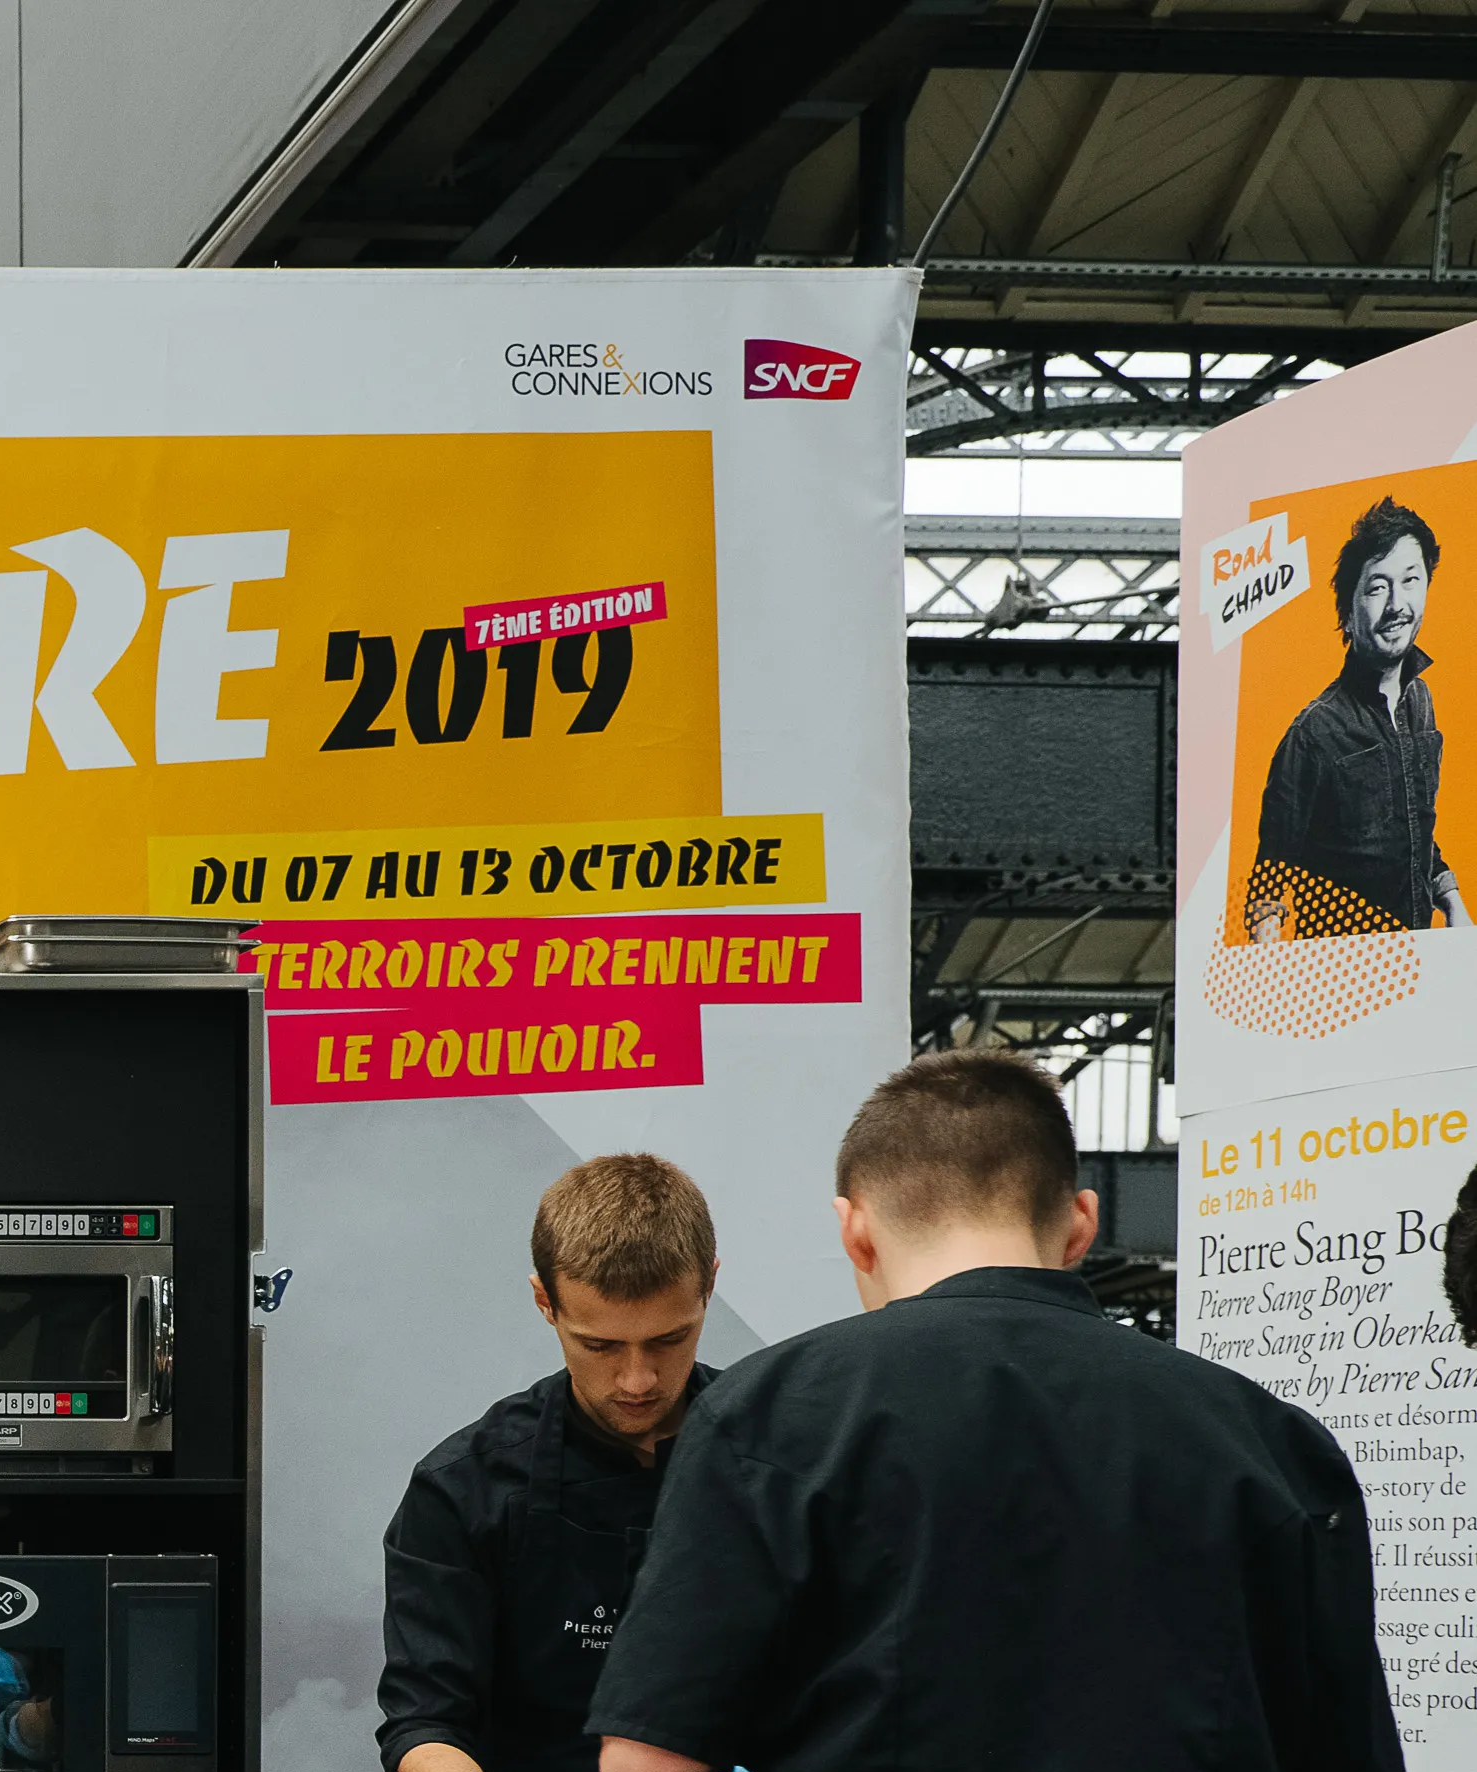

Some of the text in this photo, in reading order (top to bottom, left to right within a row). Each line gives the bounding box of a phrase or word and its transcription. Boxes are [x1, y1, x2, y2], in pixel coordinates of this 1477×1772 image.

[504, 343, 624, 370] GARES &
[511, 371, 713, 396] CONNEXIONS
[749, 362, 853, 393] SNCF
[1222, 564, 1295, 624] CHAUD
[474, 587, 654, 645] 7ÈME ÉDITION
[319, 625, 634, 752] 2019
[190, 837, 783, 905] DU 07 AU 13 OCTOBRE
[250, 936, 829, 990] TERROIRS PRENNENT
[315, 1020, 656, 1084] LE POUVOIR.
[1201, 1107, 1469, 1179] Le 11 octobre
[1199, 1178, 1317, 1217] de 12h à 14h
[12, 1219, 20, 1231] 6
[29, 1219, 37, 1231] 7
[45, 1219, 53, 1231] 8
[61, 1219, 69, 1231] 9
[78, 1219, 86, 1231] 0
[1198, 1233, 1286, 1278] Pierre
[1293, 1220, 1387, 1275] Sang
[1196, 1275, 1394, 1321] Pierre Sang Boyer
[1198, 1332, 1255, 1361] Pierre
[1257, 1325, 1316, 1364] Sang
[1319, 1321, 1345, 1352] in
[1306, 1363, 1335, 1407] by
[1338, 1362, 1420, 1395] Pierre
[11, 1398, 18, 1409] 8
[27, 1398, 34, 1409] 9
[43, 1398, 50, 1409] 0
[1374, 1411, 1393, 1428] et
[1354, 1437, 1465, 1468] Bibimbap,
[1440, 1472, 1467, 1497] de
[1408, 1515, 1446, 1532] son
[1393, 1543, 1408, 1567] Il
[1407, 1651, 1440, 1681] gré
[1389, 1684, 1477, 1717] des prod
